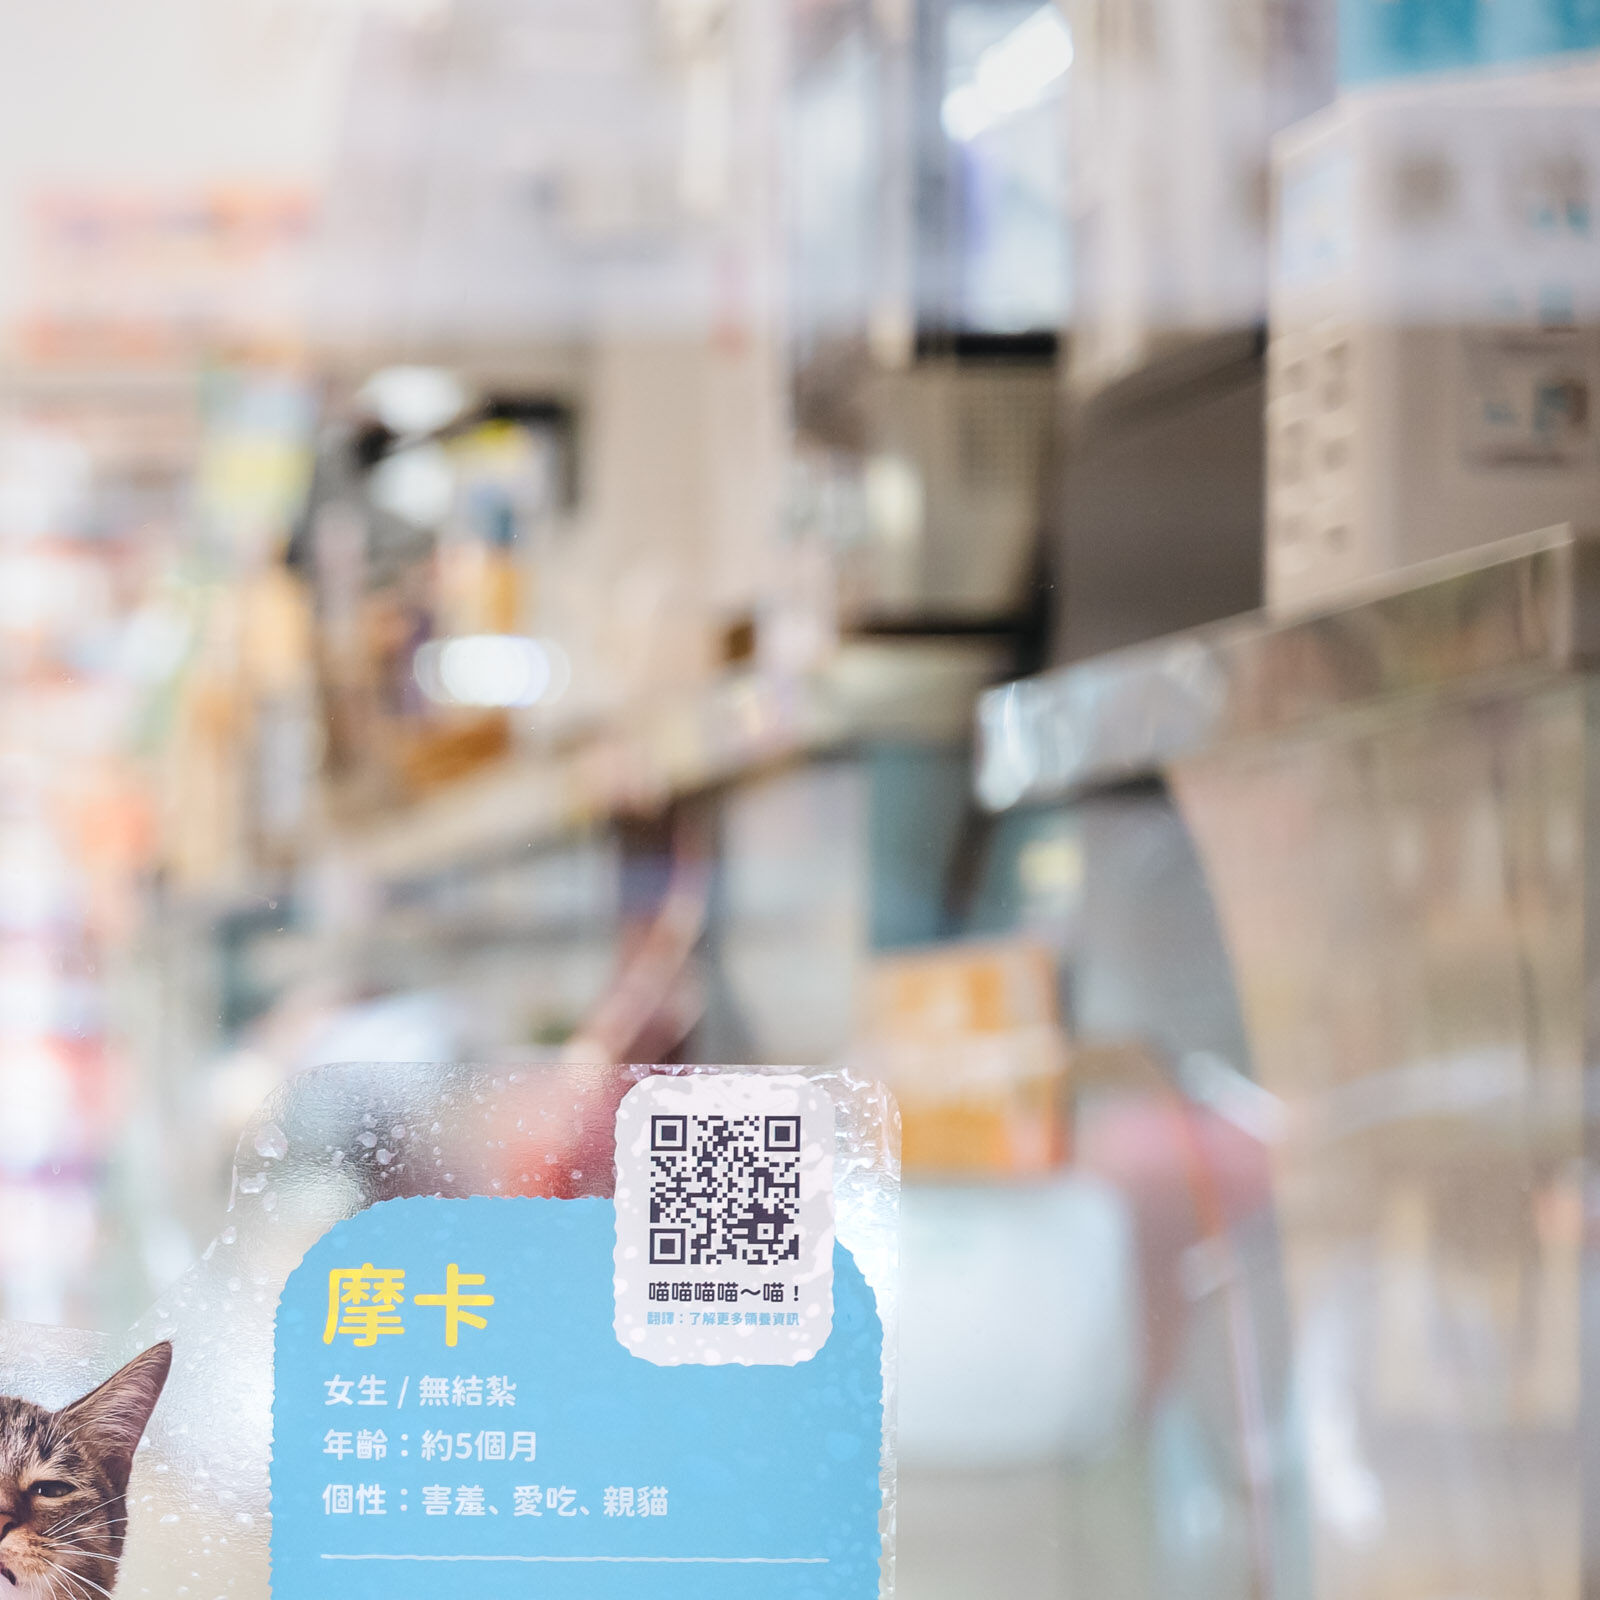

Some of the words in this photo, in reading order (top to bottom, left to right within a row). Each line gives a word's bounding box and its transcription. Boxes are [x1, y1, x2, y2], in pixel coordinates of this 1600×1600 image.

[323, 1262, 496, 1347] 摩卡
[325, 1375, 387, 1407] 女生
[419, 1375, 518, 1408] 無結紮
[323, 1430, 538, 1464] 年齡：約5個月
[322, 1483, 670, 1519] 個性：害羞、愛吃、親貓
